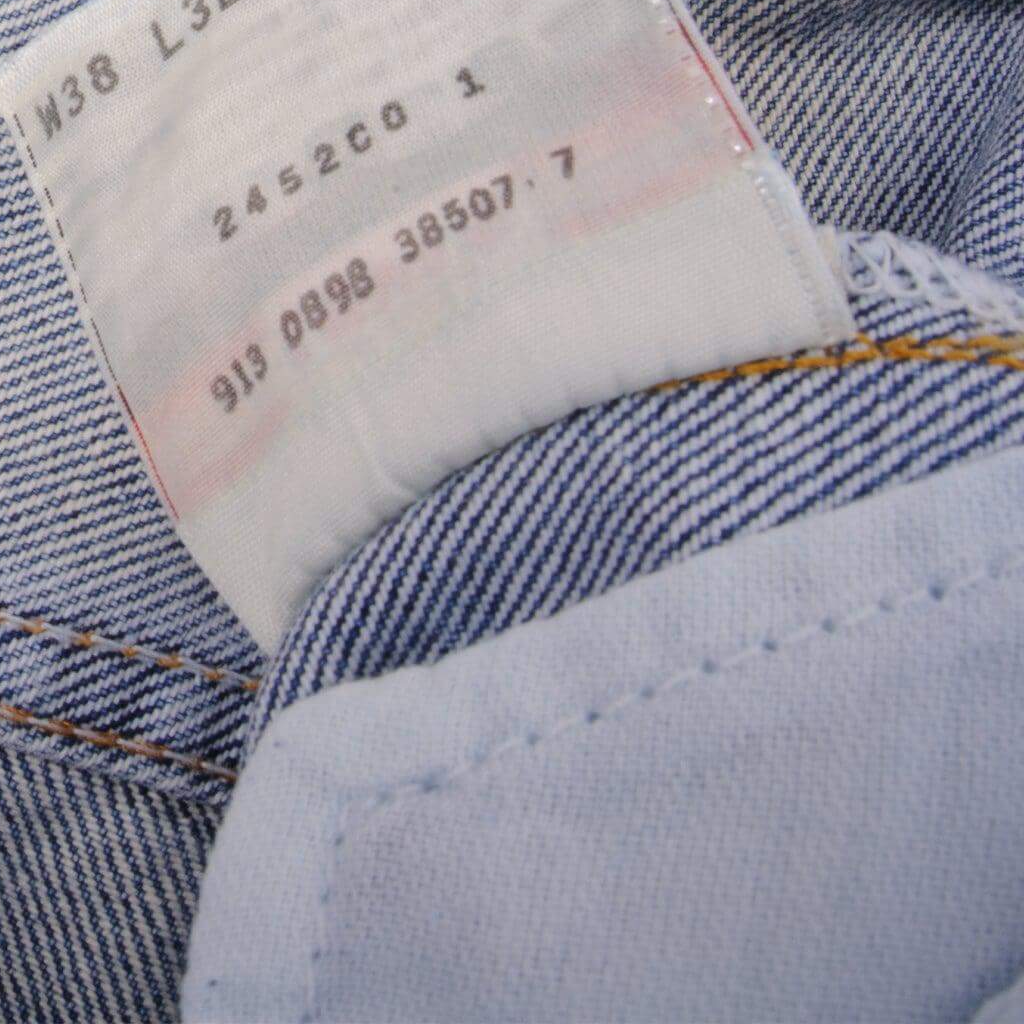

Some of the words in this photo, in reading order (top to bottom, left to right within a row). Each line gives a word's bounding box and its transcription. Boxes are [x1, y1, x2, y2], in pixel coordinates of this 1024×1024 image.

[35, 54, 121, 142] W38
[455, 66, 485, 98] 1
[210, 343, 268, 414] 913
